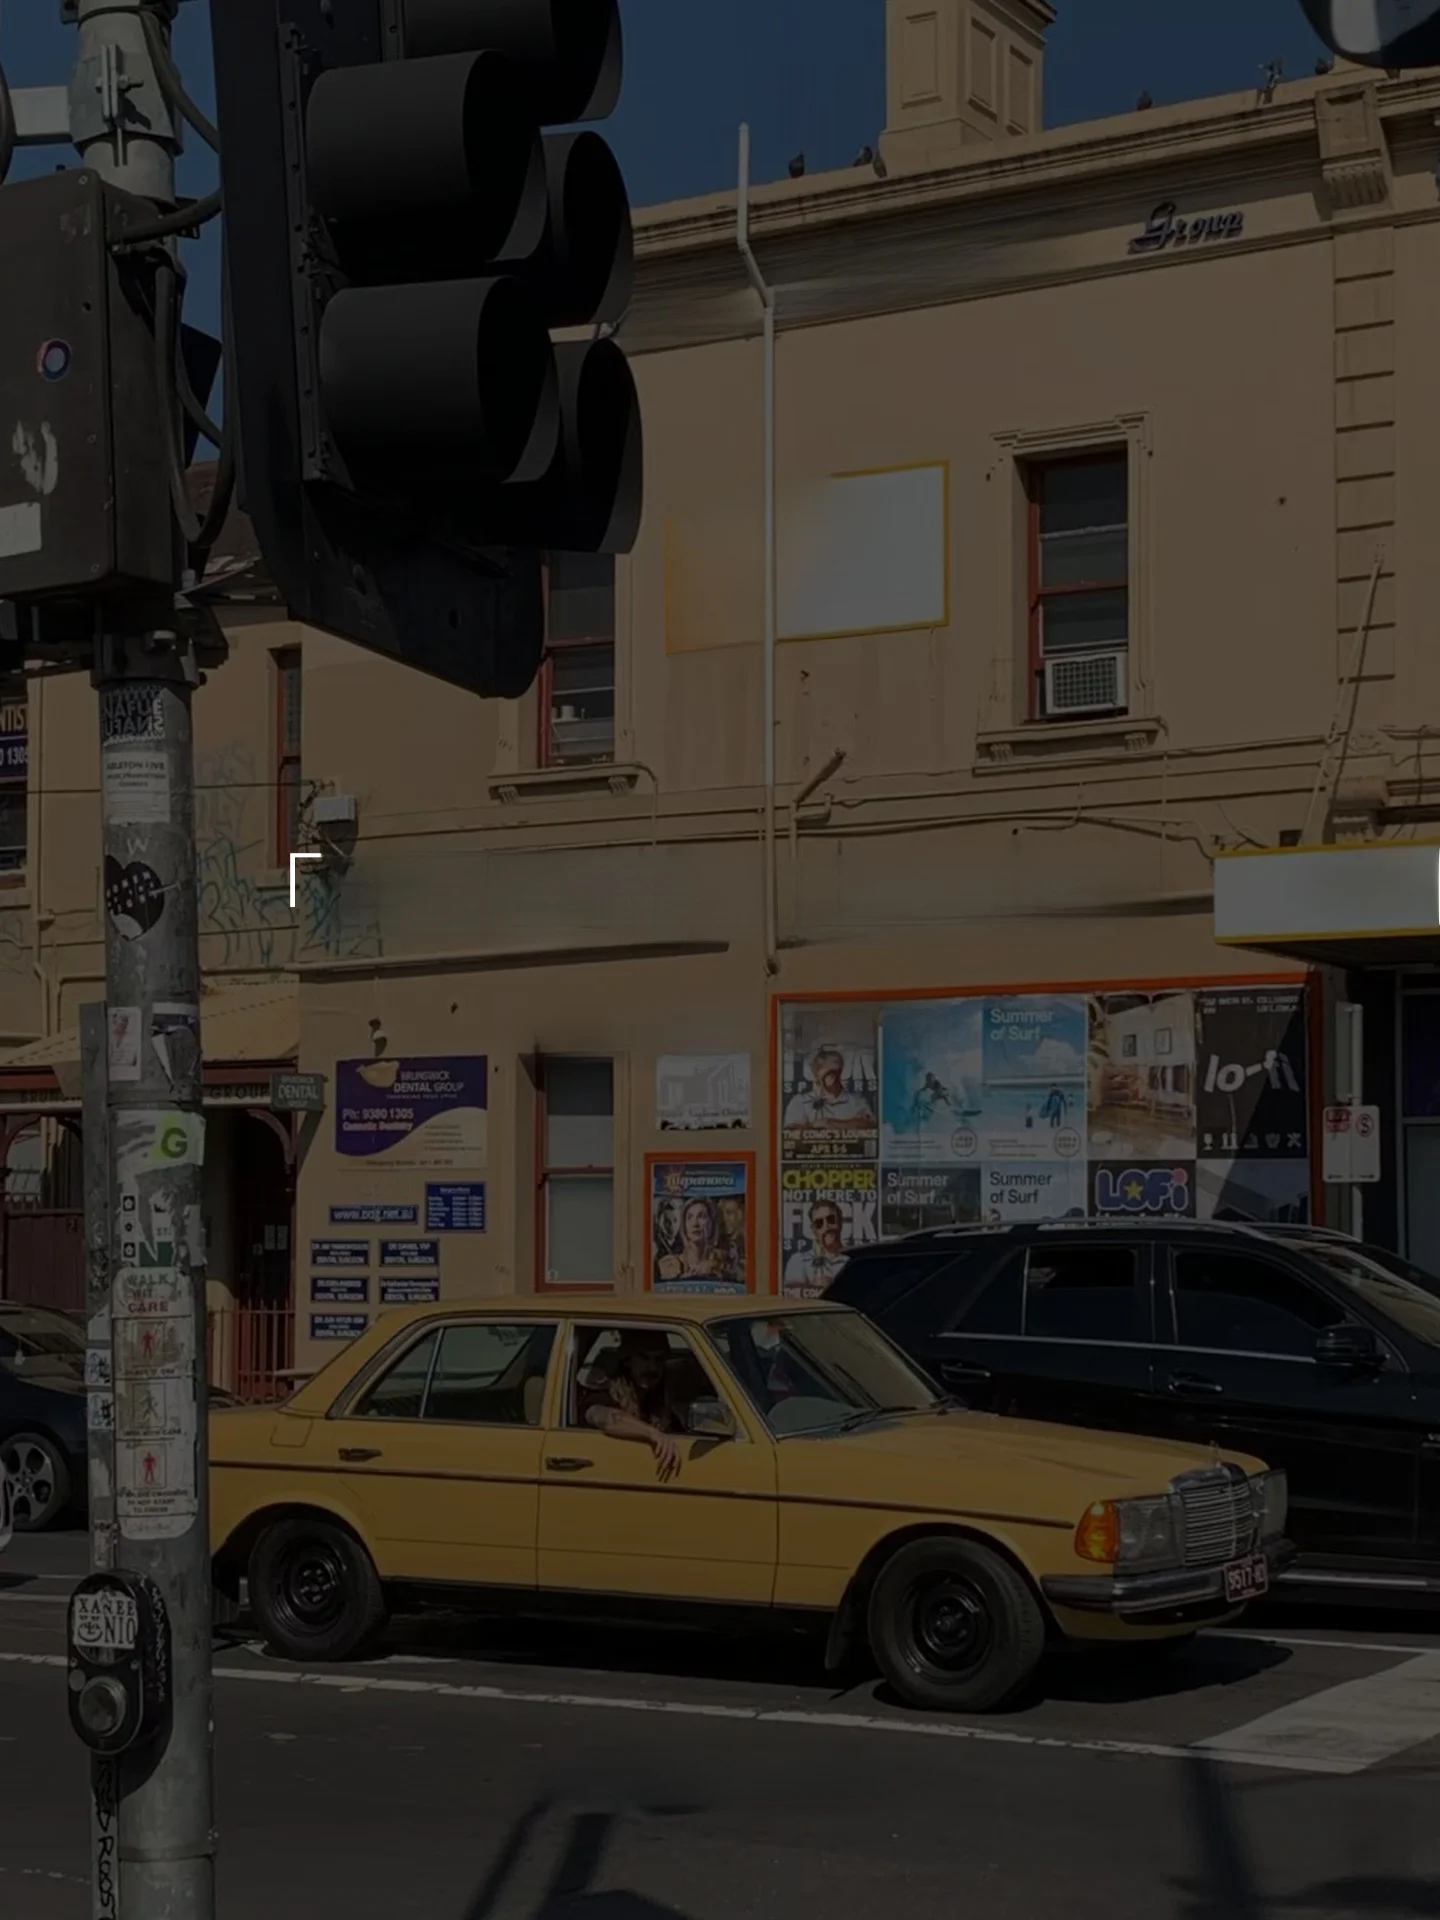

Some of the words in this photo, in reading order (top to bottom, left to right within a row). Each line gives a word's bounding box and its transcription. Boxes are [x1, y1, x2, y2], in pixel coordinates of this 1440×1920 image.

[990, 1008, 1054, 1024] Summer
[990, 1026, 1004, 1041] of
[1007, 1026, 1041, 1041] Surf
[278, 1084, 318, 1100] DENTAL
[393, 1082, 432, 1093] DENTAL
[782, 1169, 876, 1190] CHOPPER
[887, 1172, 948, 1187] Summer
[990, 1171, 1052, 1187] Summer
[783, 1190, 812, 1203] NOT
[816, 1190, 854, 1203] HERE
[857, 1190, 877, 1202] TO
[887, 1189, 901, 1204] of
[903, 1189, 936, 1204] Surf
[990, 1188, 1005, 1204] of
[1007, 1188, 1040, 1204] Surf
[128, 1301, 169, 1313] CARE
